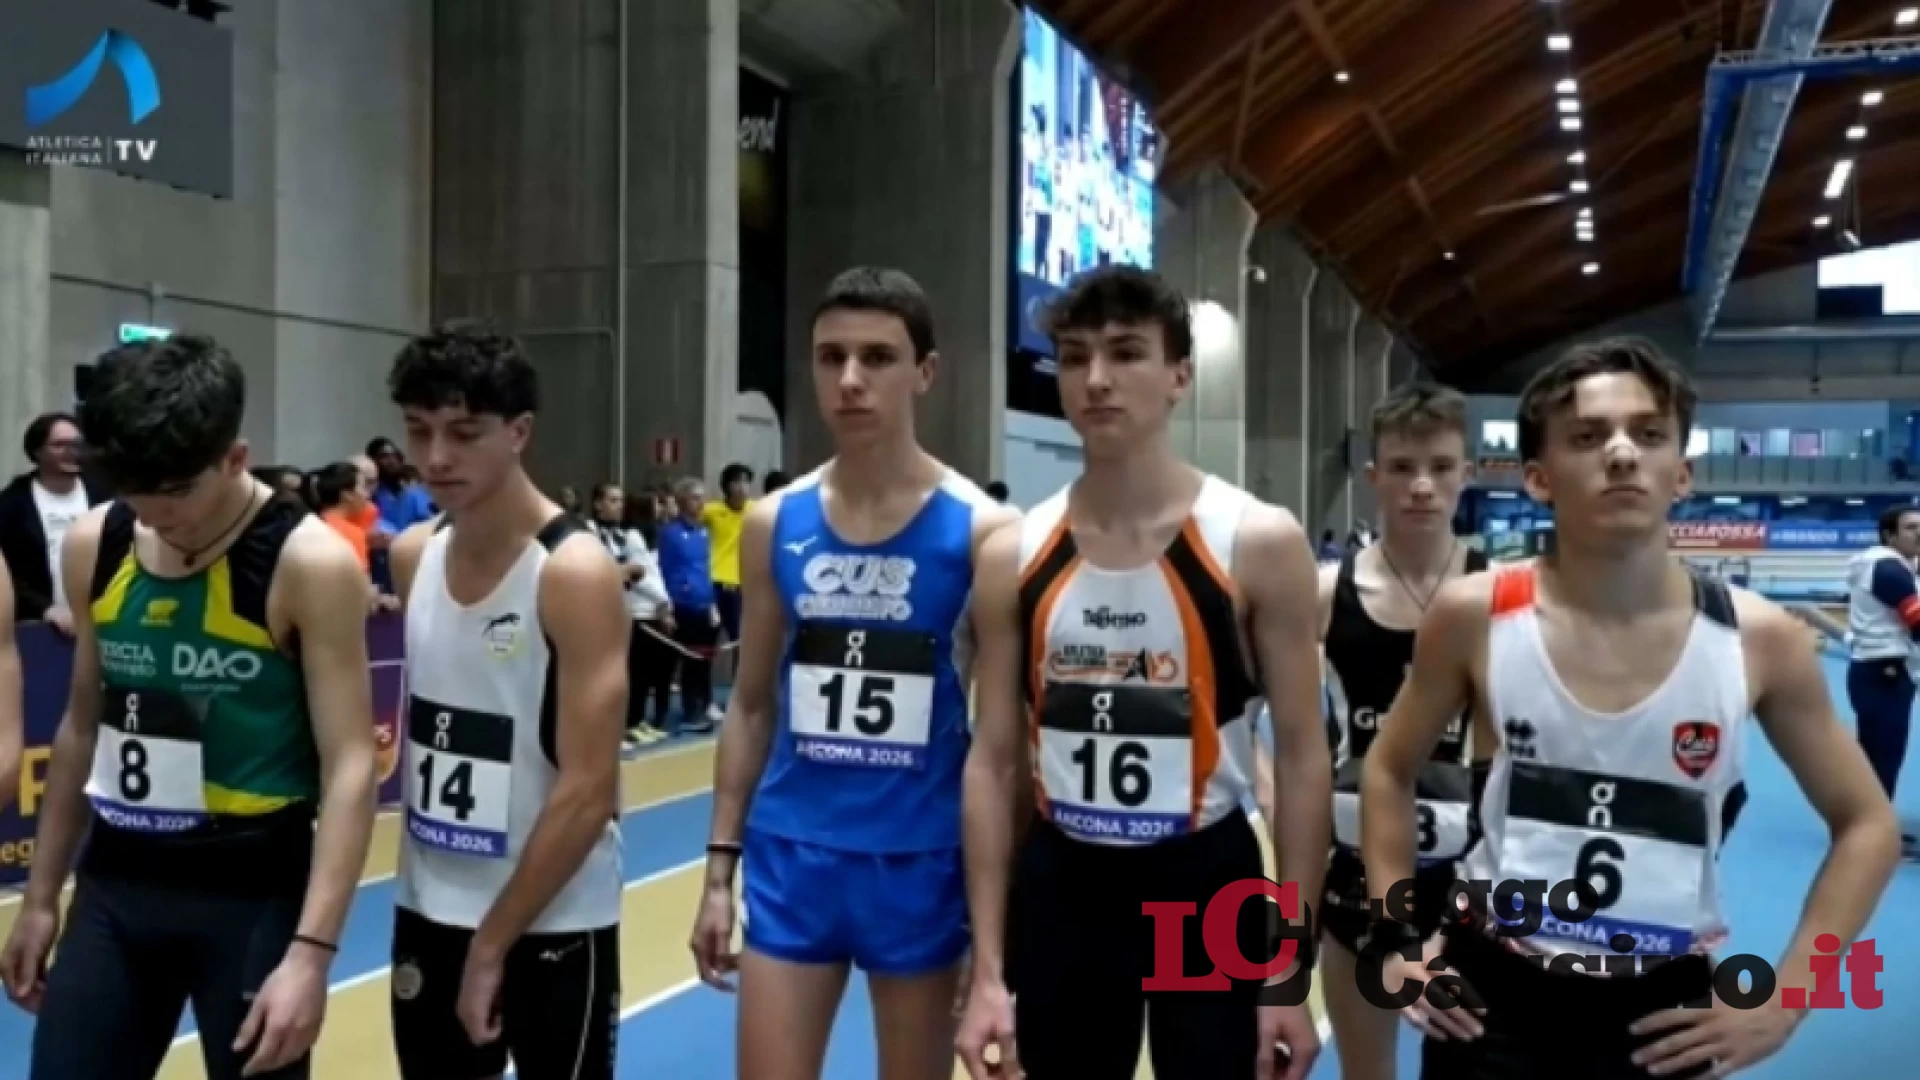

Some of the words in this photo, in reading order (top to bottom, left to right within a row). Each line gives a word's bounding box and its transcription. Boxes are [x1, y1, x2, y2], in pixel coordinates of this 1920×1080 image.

[804, 554, 917, 595] CUS
[172, 641, 263, 680] DAO
[819, 672, 895, 736] 15
[120, 739, 149, 801] 8
[418, 753, 475, 820] 14
[1072, 737, 1152, 808] 16
[452, 831, 494, 852] 2026
[1575, 838, 1625, 909] 6
